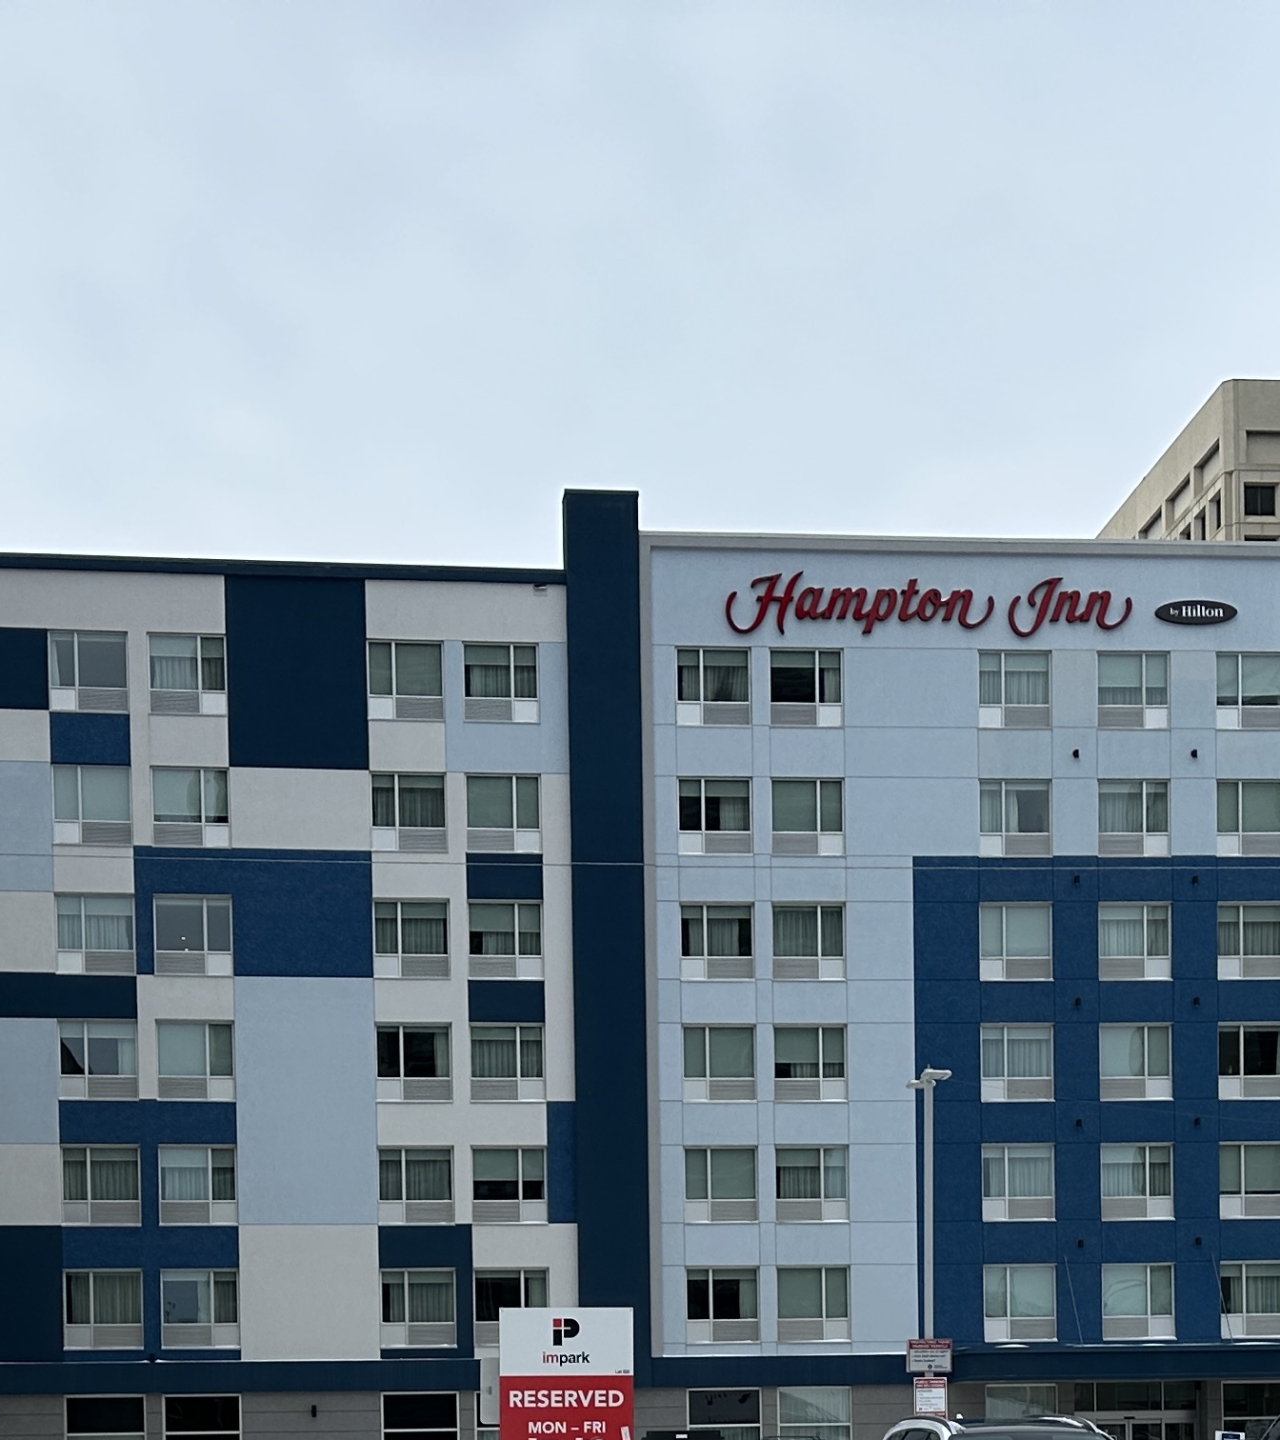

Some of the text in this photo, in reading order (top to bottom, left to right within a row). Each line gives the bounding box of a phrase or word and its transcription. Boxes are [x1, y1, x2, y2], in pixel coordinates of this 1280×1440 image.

[725, 570, 1132, 638] Hampton Inn
[1169, 605, 1224, 619] by Hilton
[542, 1351, 590, 1366] impark
[509, 1390, 624, 1408] RESERVED
[528, 1421, 567, 1433] MON
[583, 1421, 606, 1433] FRI
